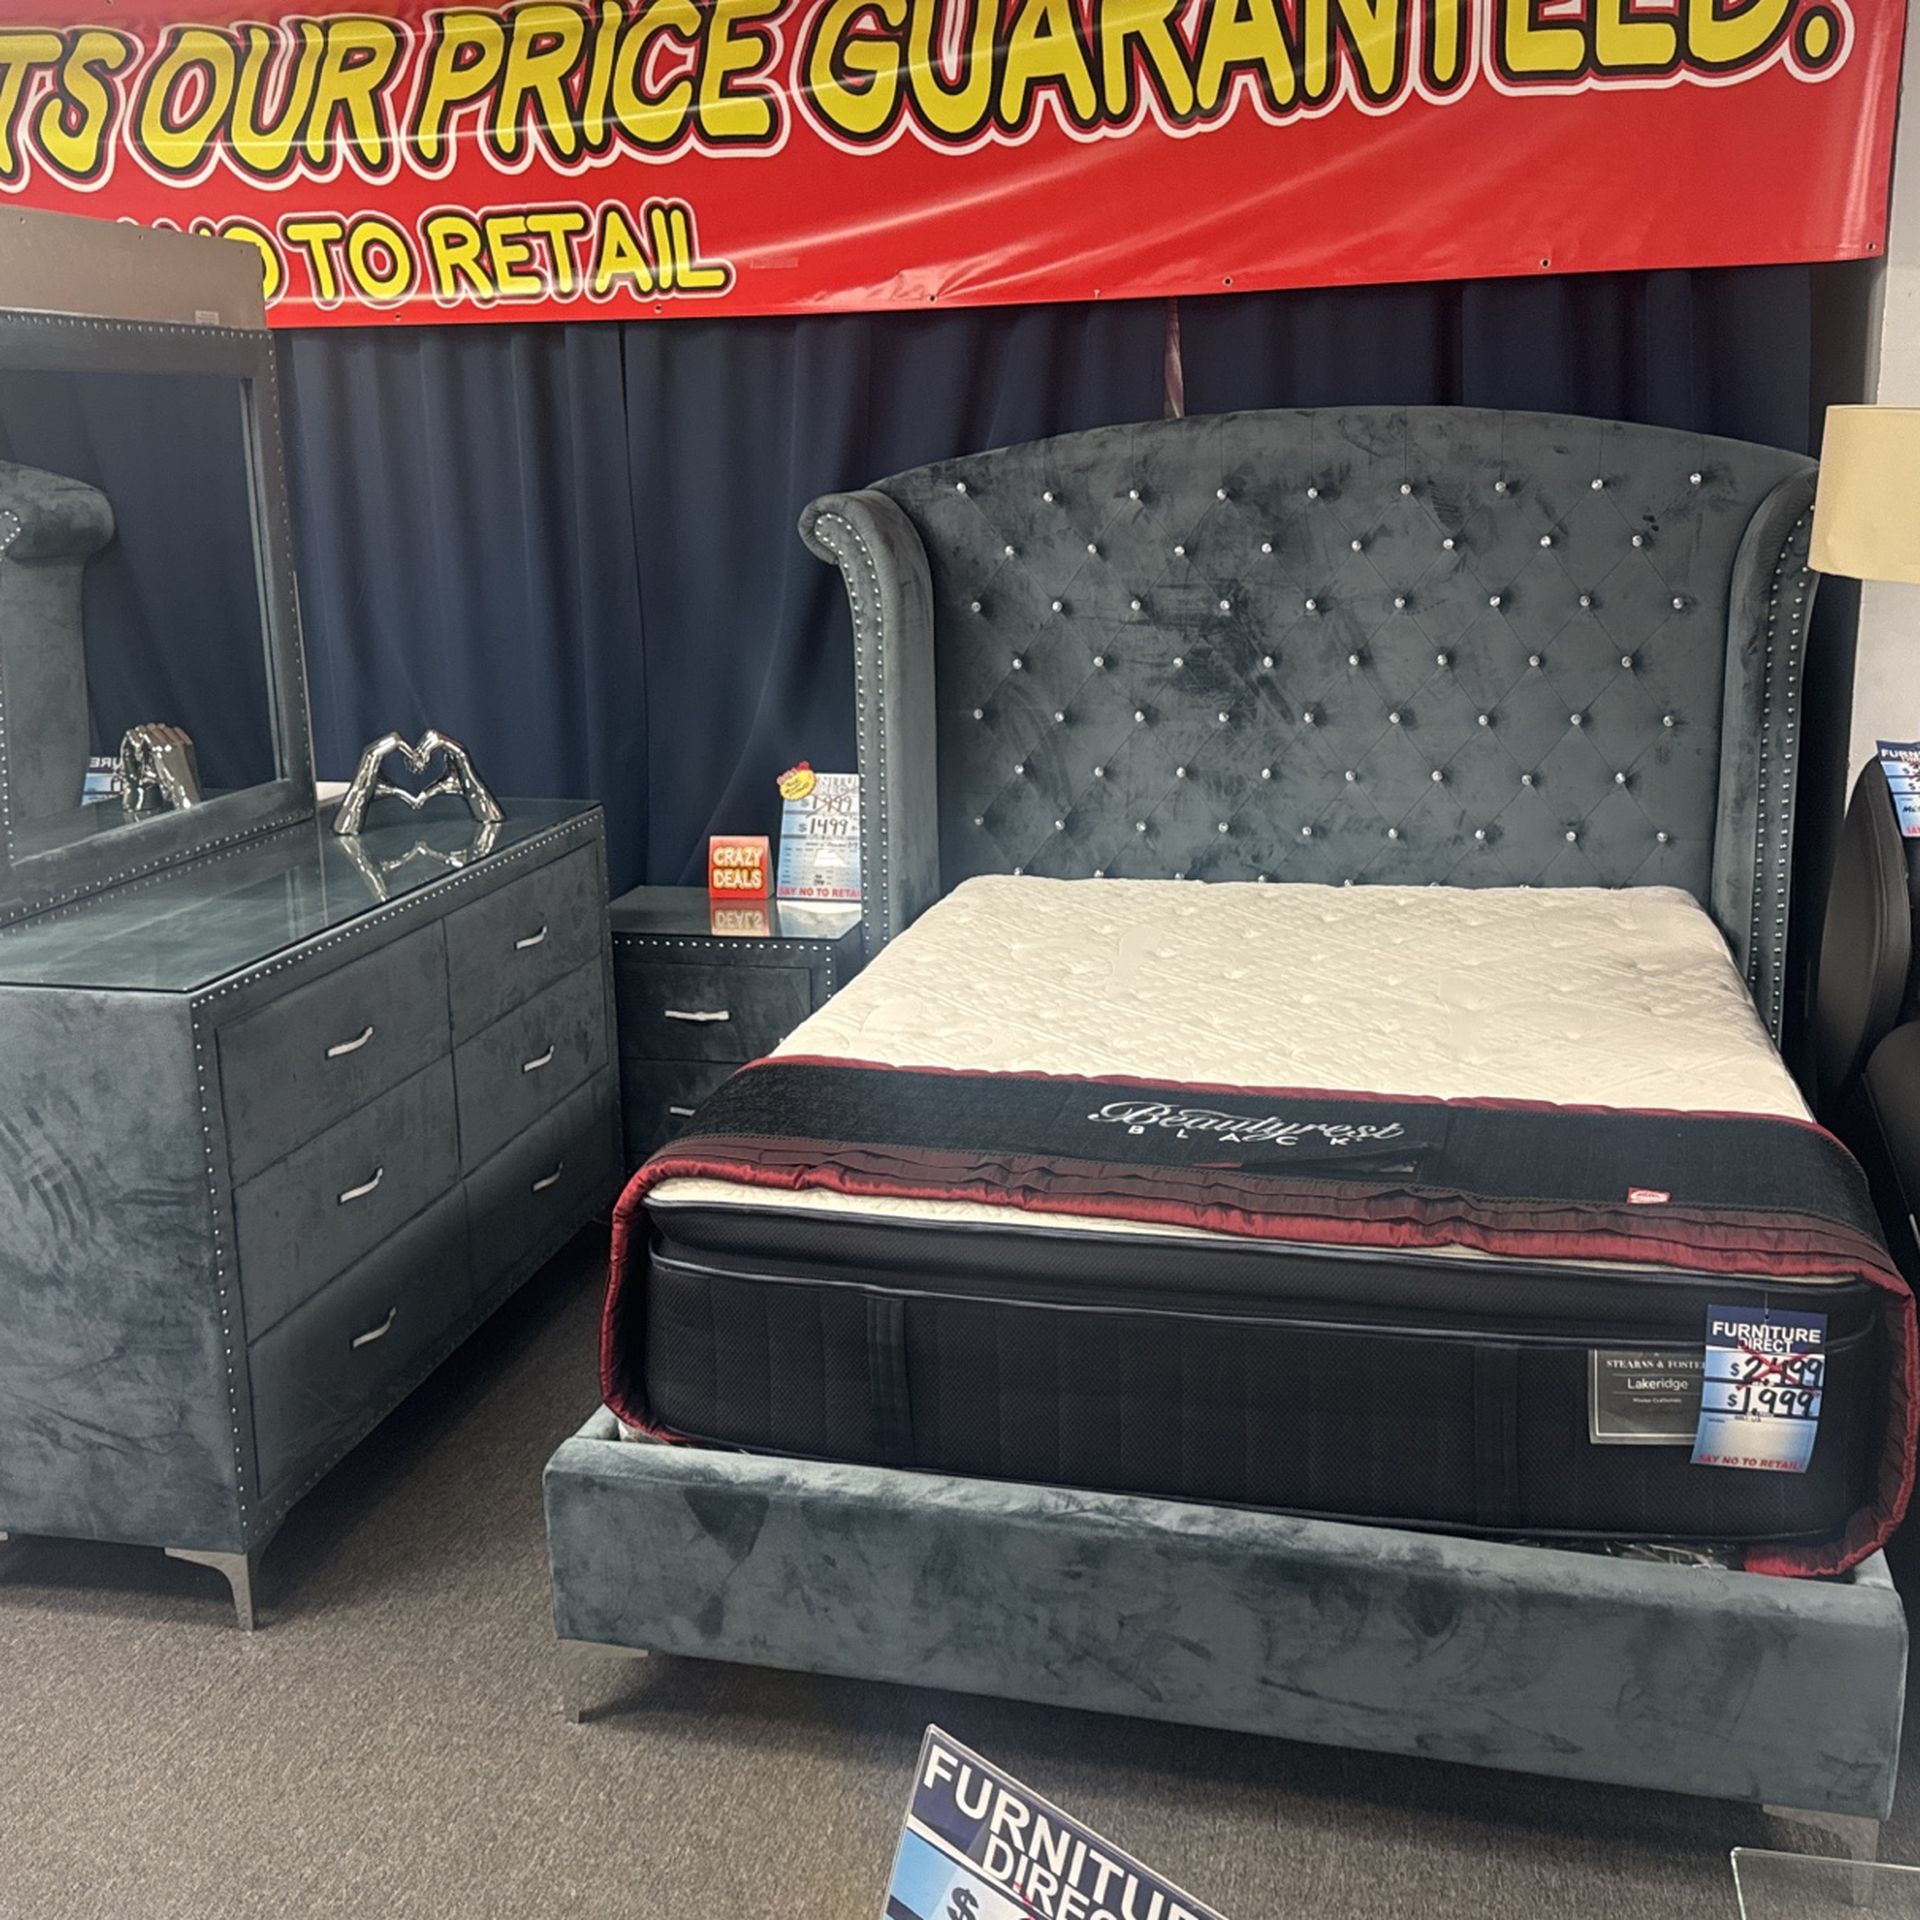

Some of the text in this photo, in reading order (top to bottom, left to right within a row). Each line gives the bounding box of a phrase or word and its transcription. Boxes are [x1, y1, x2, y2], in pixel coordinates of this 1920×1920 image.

[129, 15, 406, 184] OUR
[410, 0, 782, 169] PRICE
[280, 213, 418, 307] TO
[422, 200, 732, 306] RETAIL
[712, 846, 764, 868] CRAZY
[712, 868, 764, 890] DEALS
[799, 888, 813, 898] NO
[816, 888, 830, 898] TO
[1087, 1100, 1405, 1142] Beautyrest
[1127, 1124, 1350, 1146] BLACK
[1712, 1321, 1821, 1344] FURNITURE
[1738, 1337, 1794, 1354] DIRECT
[1627, 1377, 1689, 1391] Lakeridge
[1722, 1455, 1739, 1465] NO
[1742, 1457, 1757, 1467] TO
